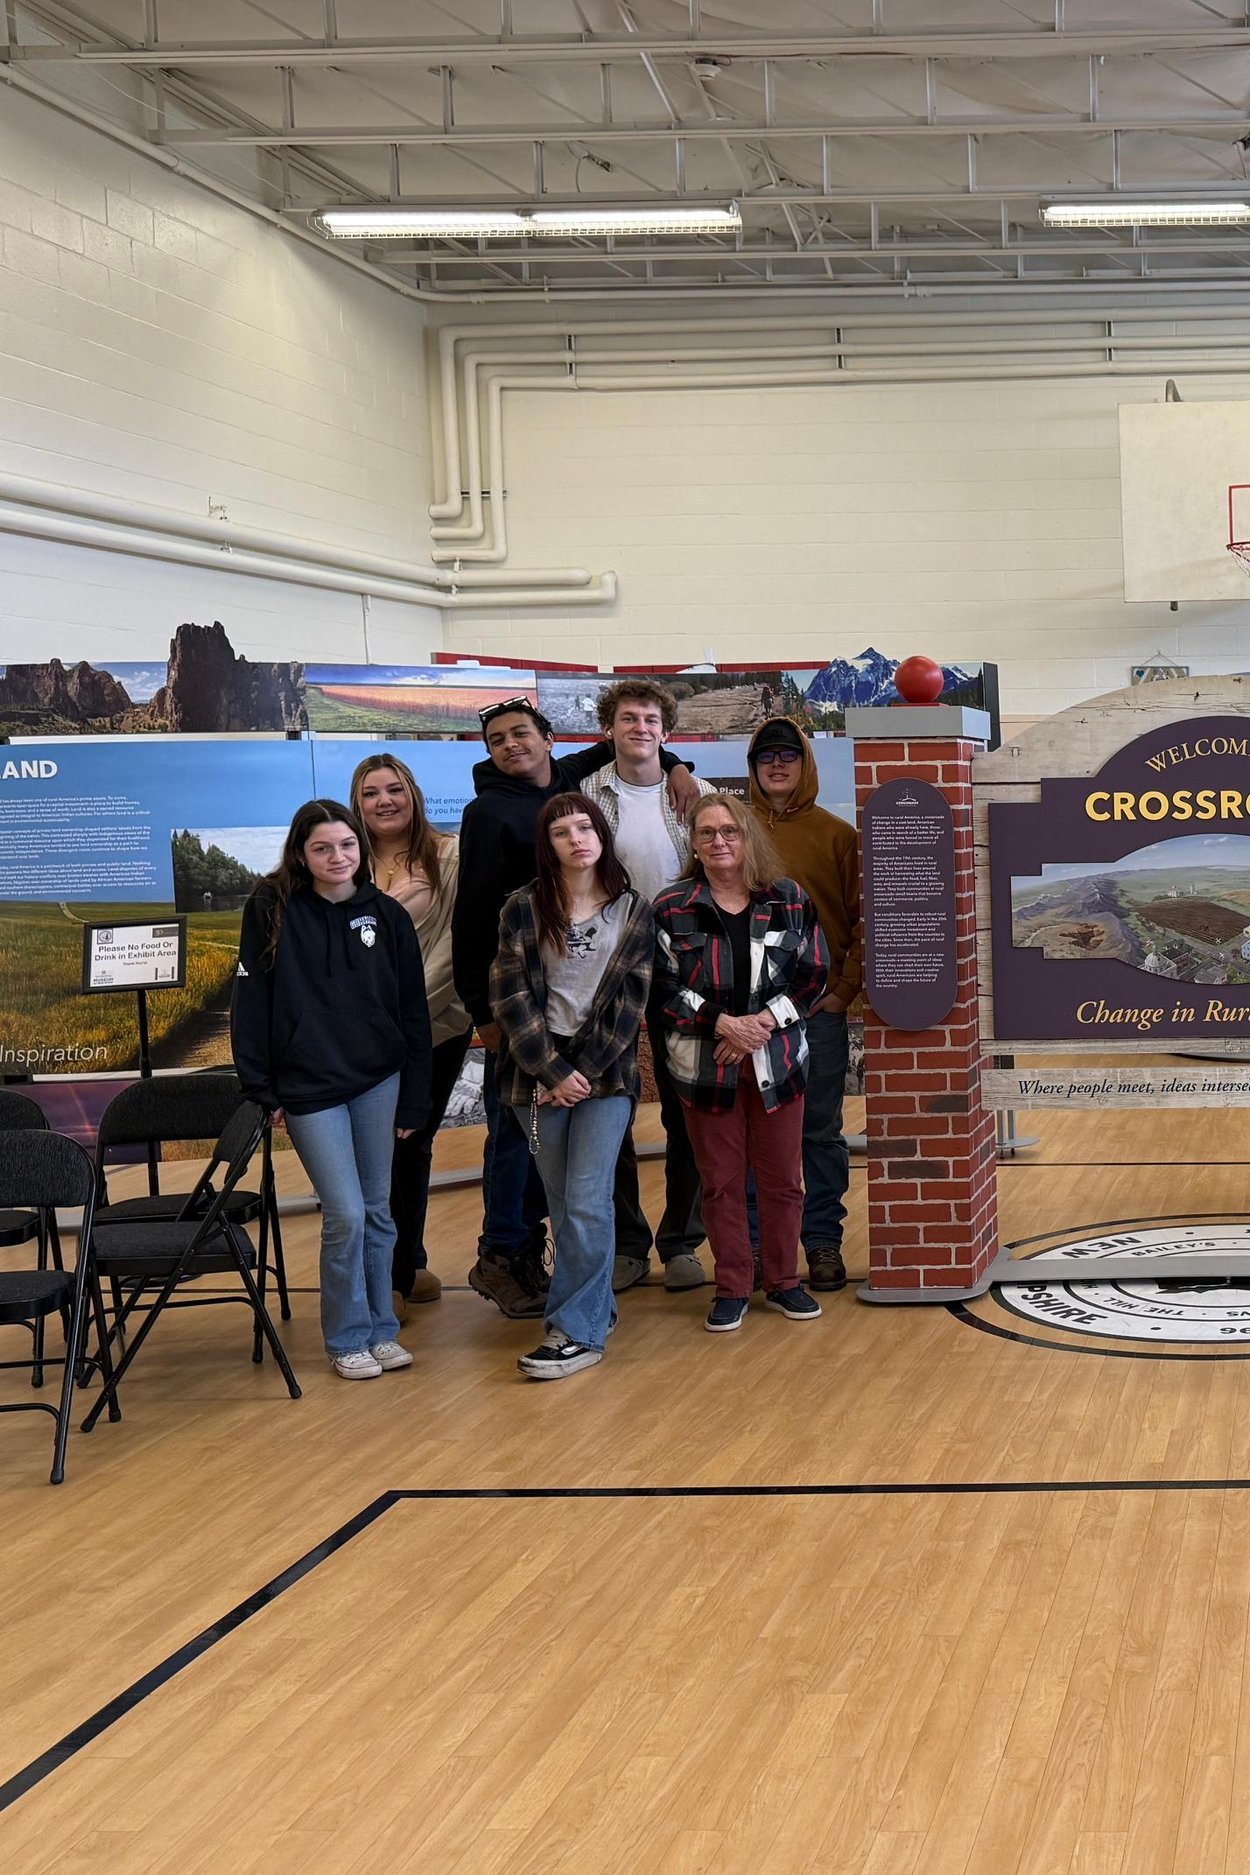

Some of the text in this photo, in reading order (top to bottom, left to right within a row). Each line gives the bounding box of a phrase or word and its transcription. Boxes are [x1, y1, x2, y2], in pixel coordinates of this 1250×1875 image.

[0, 760, 58, 780] AND
[720, 786, 745, 795] Place
[1076, 1000, 1164, 1031] Change
[1171, 1002, 1196, 1023] in
[0, 1045, 108, 1067] Inspiration
[1018, 1080, 1063, 1094] Where
[1067, 1079, 1113, 1098] people
[1118, 1081, 1155, 1094] meet,
[1160, 1078, 1197, 1092] ideas
[1061, 1237, 1142, 1258] NEW
[1130, 1241, 1216, 1256] BAILEY'S
[1017, 1284, 1108, 1324] PSHIRE
[1104, 1297, 1139, 1310] HILL
[1144, 1307, 1184, 1316] THE
